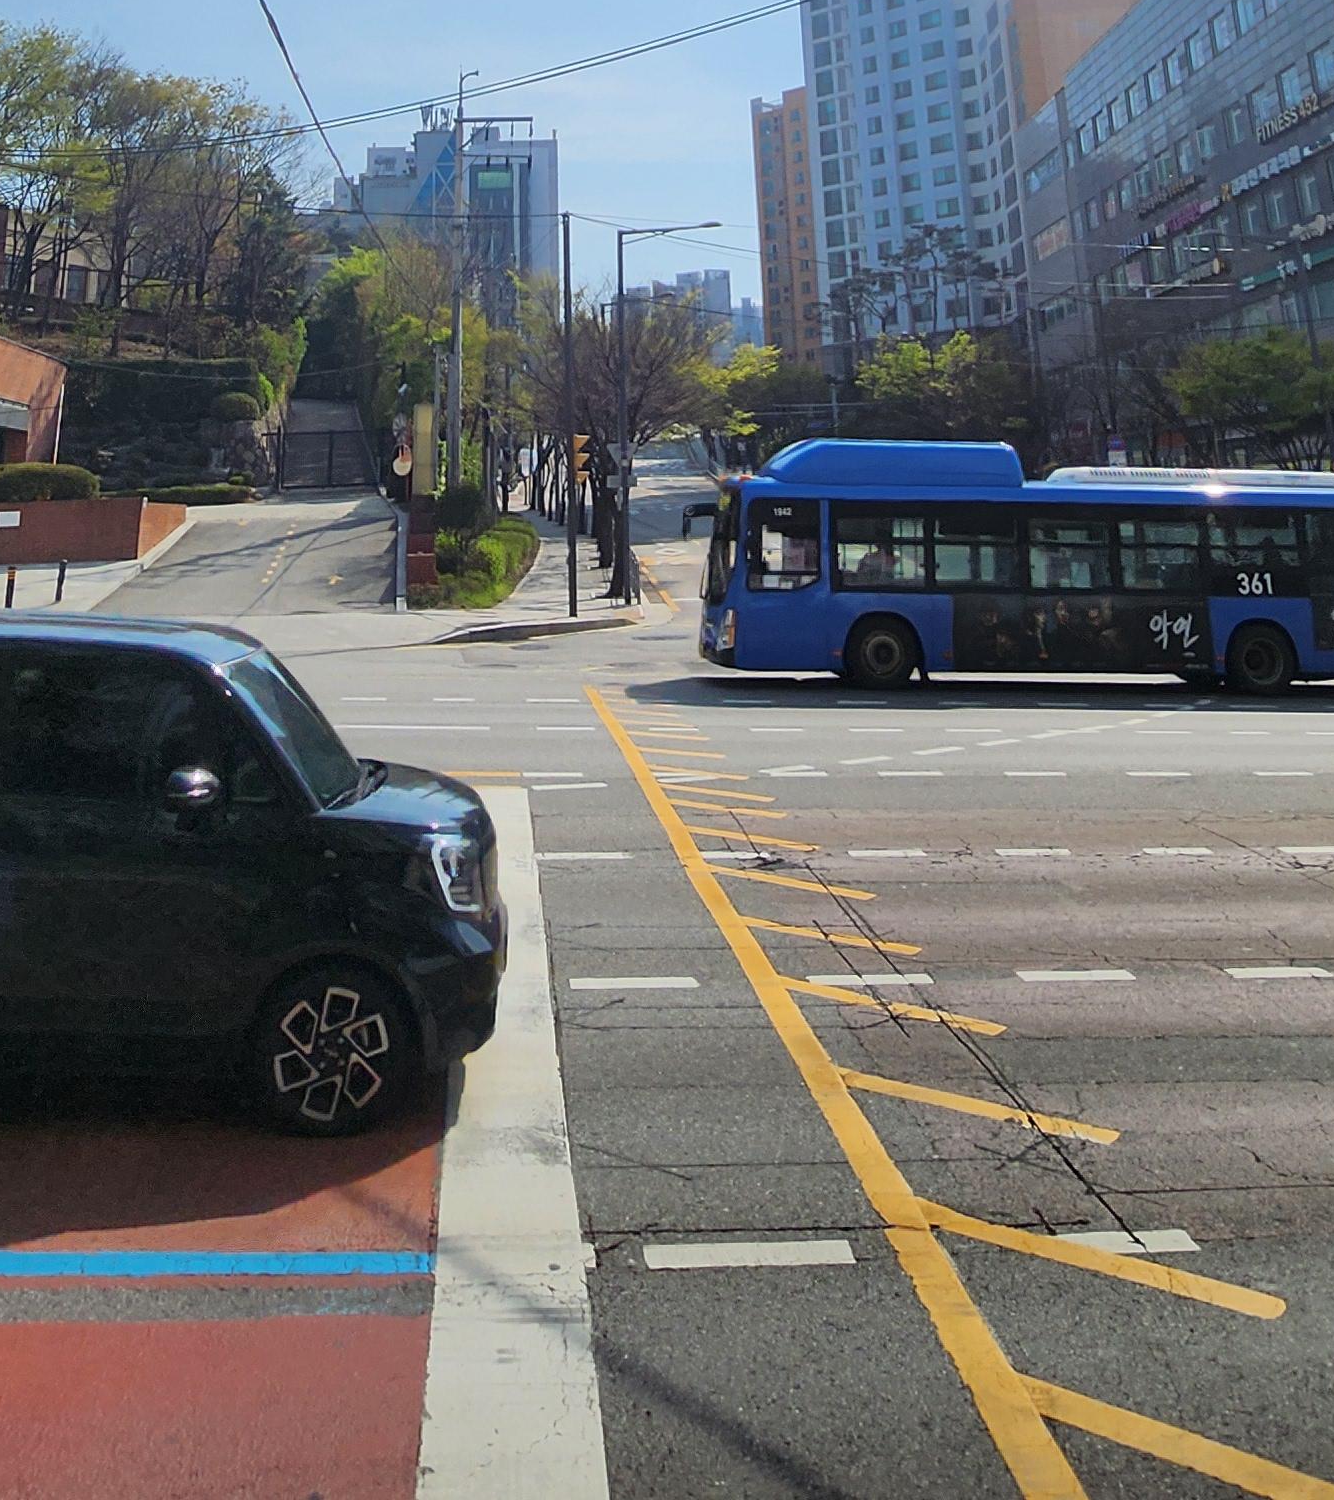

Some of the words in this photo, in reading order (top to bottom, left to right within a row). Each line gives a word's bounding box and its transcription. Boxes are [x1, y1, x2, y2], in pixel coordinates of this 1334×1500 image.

[1255, 105, 1299, 145] FITNESS
[1297, 92, 1321, 119] 452
[773, 507, 793, 517] 1942
[1236, 572, 1273, 596] 361
[1149, 609, 1200, 650] 악연
